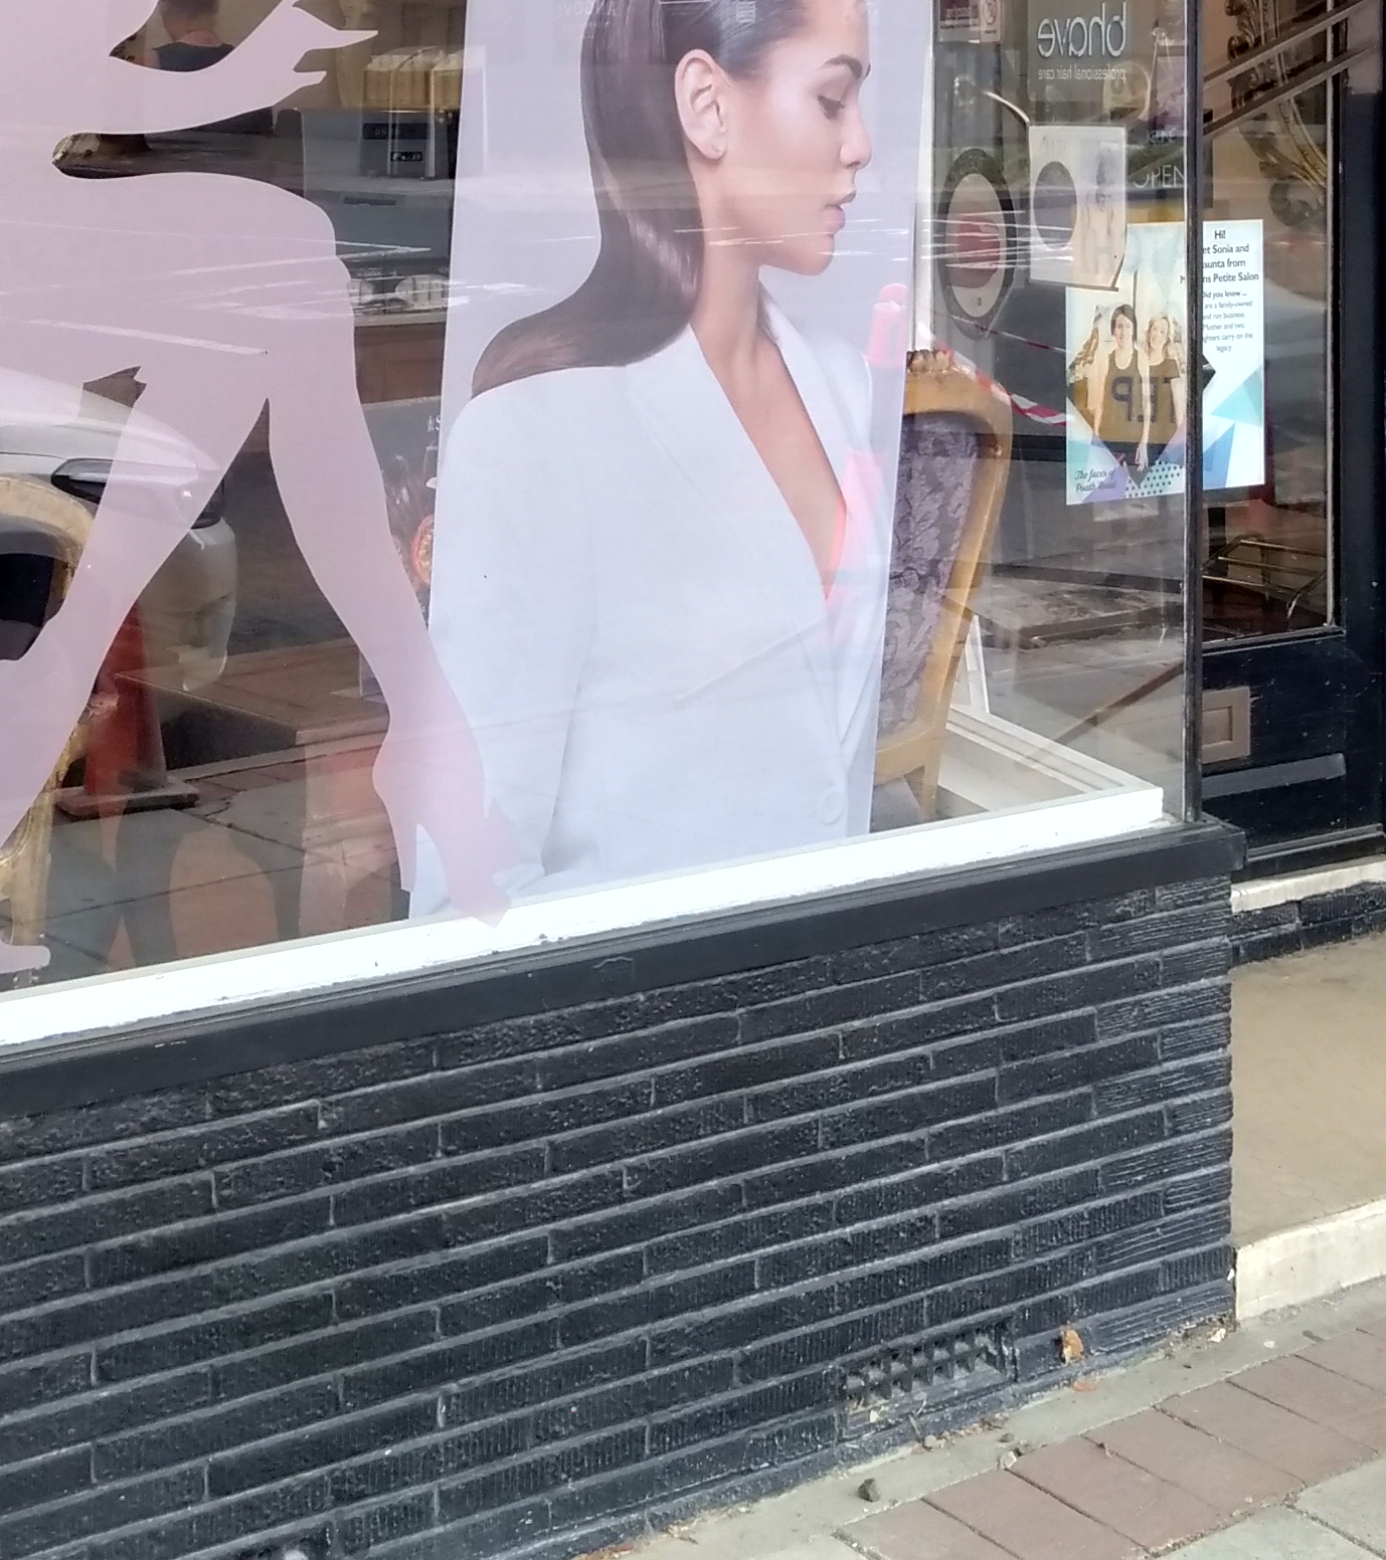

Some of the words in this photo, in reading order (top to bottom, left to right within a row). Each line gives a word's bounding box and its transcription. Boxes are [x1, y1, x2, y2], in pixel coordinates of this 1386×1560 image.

[1214, 230, 1226, 240] Hi!
[1213, 244, 1233, 254] Sonia
[1235, 243, 1249, 253] and
[1227, 258, 1246, 268] from
[1213, 273, 1236, 283] Petite
[1237, 272, 1259, 282] Salon
